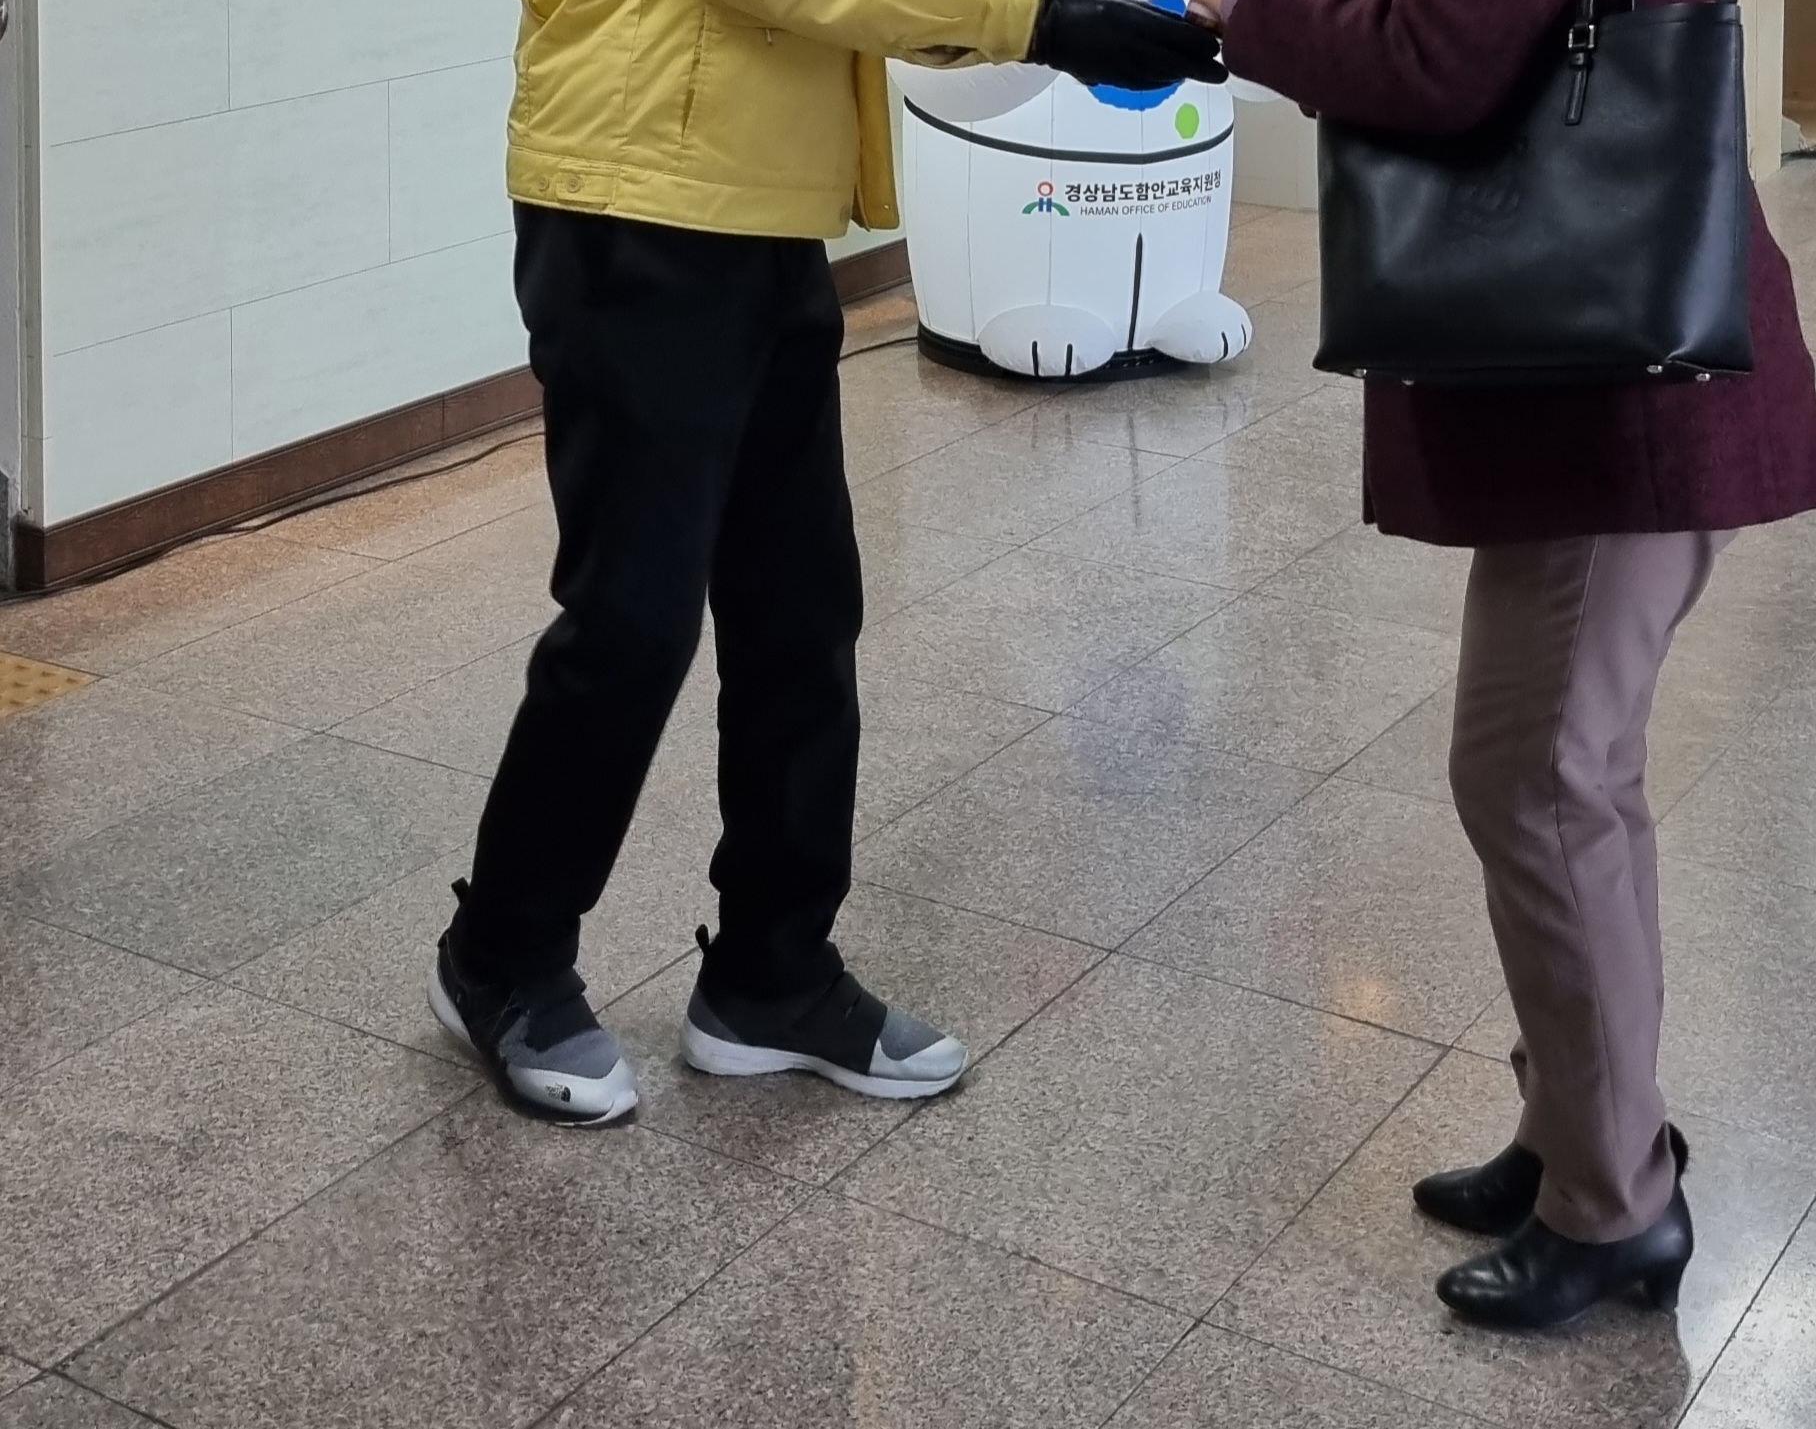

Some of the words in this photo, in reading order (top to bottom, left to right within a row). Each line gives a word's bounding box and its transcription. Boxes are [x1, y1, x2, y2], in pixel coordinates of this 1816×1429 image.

[1064, 169, 1222, 203] 경상남도함안교육지원청
[1080, 206, 1119, 216] HAMAN
[1121, 204, 1155, 216] OFFICE
[1157, 203, 1169, 213] OF
[1171, 195, 1212, 212] EDUCATION
